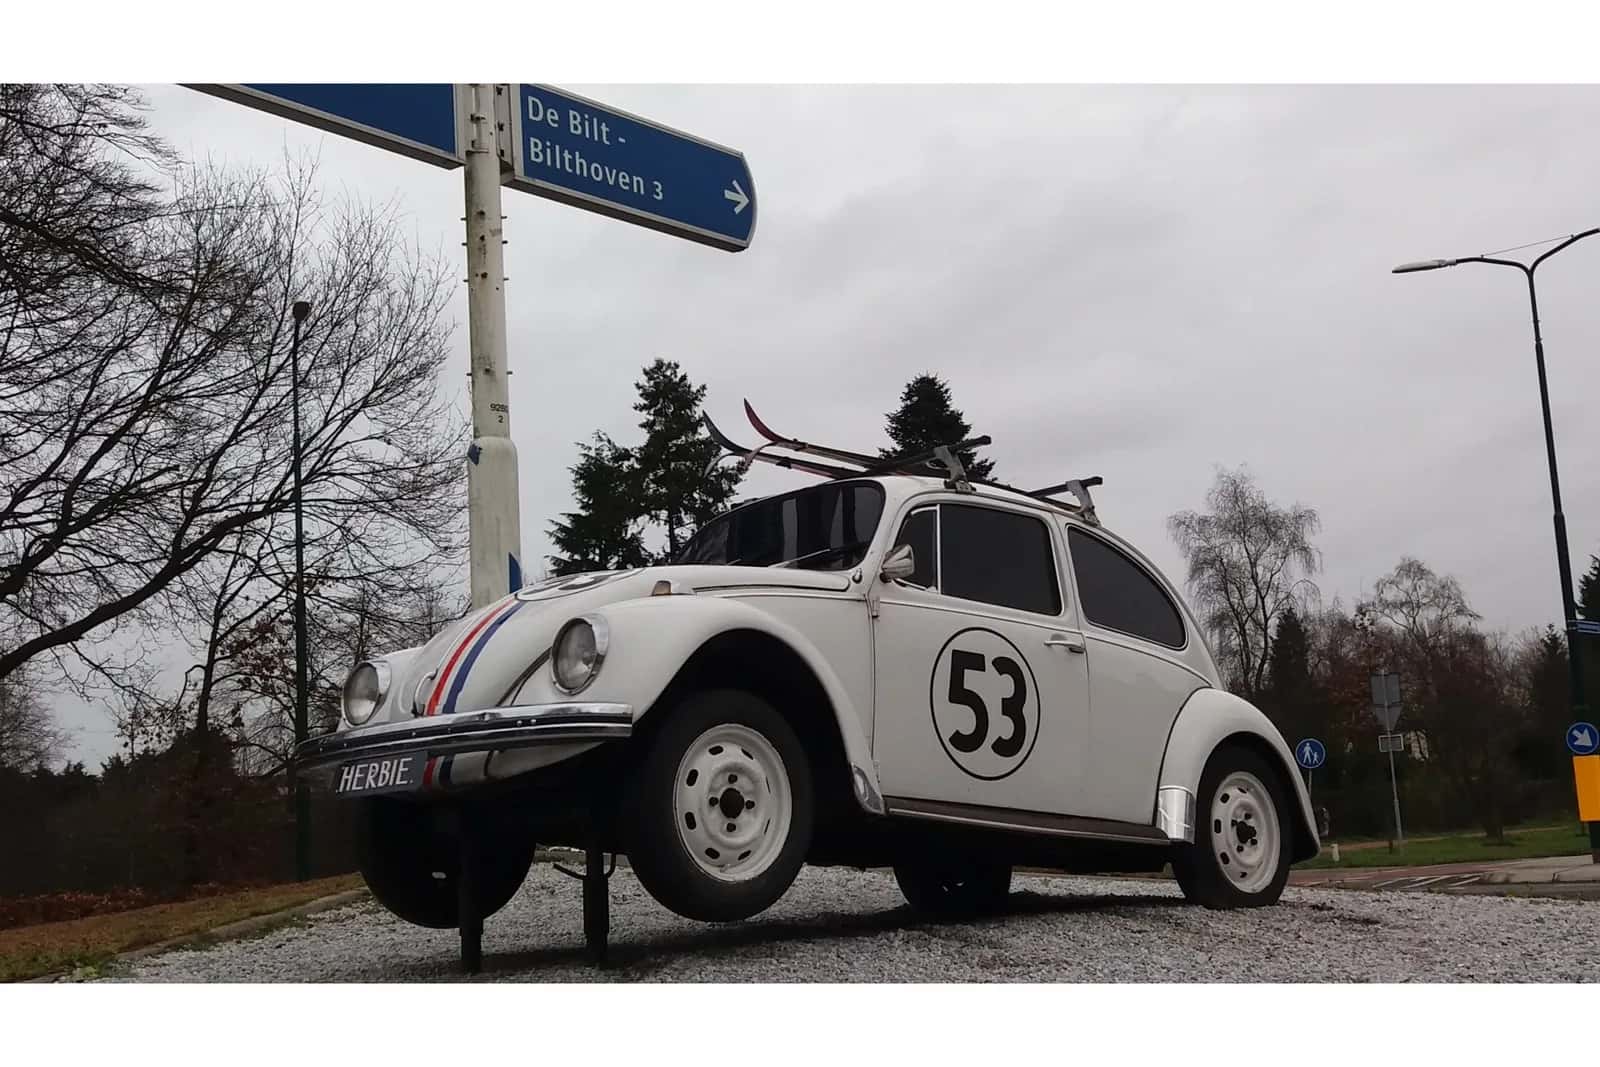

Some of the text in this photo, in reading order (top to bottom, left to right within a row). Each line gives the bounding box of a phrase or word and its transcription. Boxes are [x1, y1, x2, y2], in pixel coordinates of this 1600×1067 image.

[527, 95, 559, 128] De
[568, 109, 610, 145] Bilt
[529, 136, 664, 200] Bilthoven 3
[498, 415, 504, 424] 2
[948, 649, 1027, 758] 53
[339, 757, 413, 793] HERBIE
